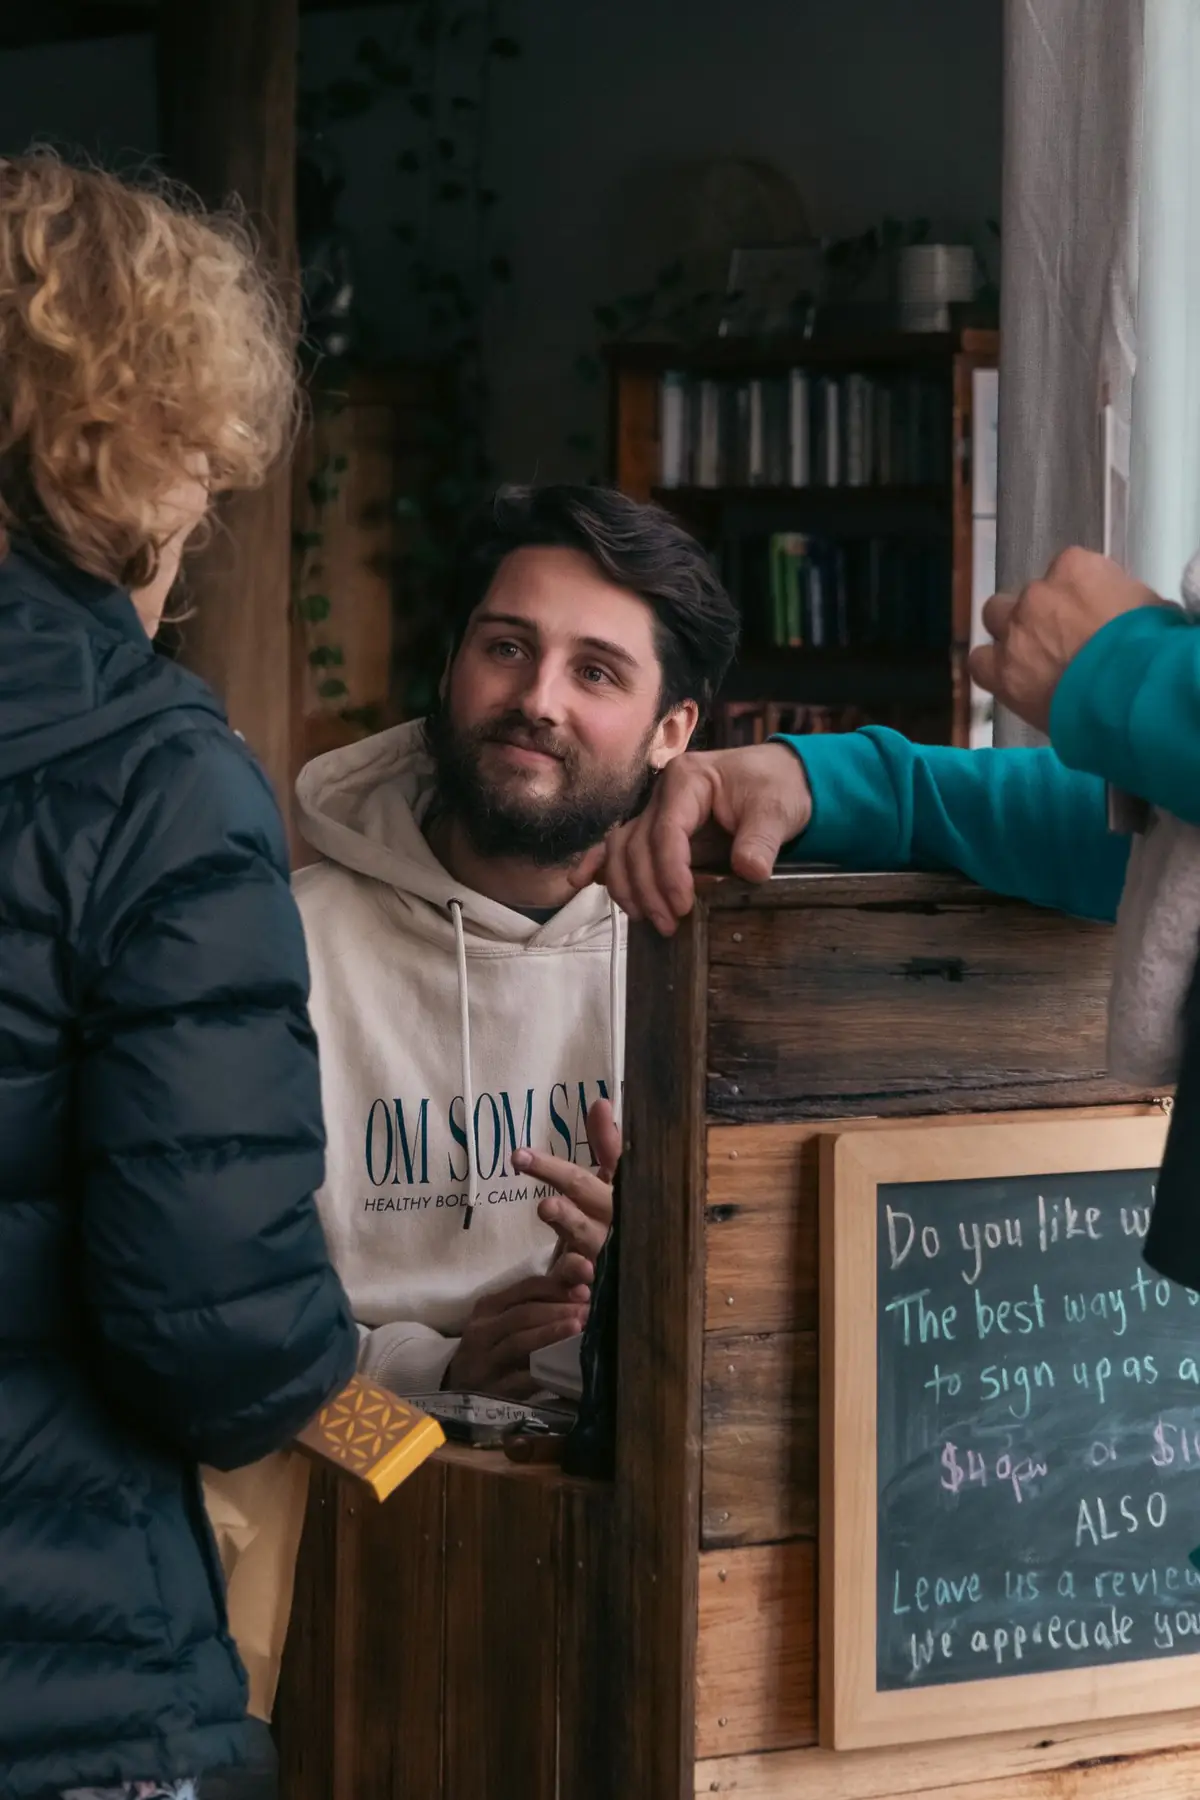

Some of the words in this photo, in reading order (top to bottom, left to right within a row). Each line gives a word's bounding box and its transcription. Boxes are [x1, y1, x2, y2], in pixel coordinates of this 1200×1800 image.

[365, 1098, 430, 1187] OM
[448, 1088, 534, 1182] SOM
[549, 1080, 624, 1167] SA
[364, 1196, 432, 1212] HEALTHY
[487, 1187, 528, 1205] CALM
[533, 1183, 562, 1199] MIN
[886, 1203, 941, 1270] Do
[959, 1218, 1023, 1286] you
[1037, 1195, 1103, 1253] like
[884, 1288, 957, 1346] The
[974, 1283, 1045, 1340] best
[1063, 1289, 1127, 1336] way
[1130, 1266, 1171, 1312] to
[924, 1364, 963, 1405] to
[980, 1354, 1055, 1420] sign
[1072, 1356, 1112, 1404] up
[1122, 1353, 1159, 1385] as
[1178, 1357, 1200, 1386] a
[1075, 1491, 1169, 1548] ALSO
[893, 1568, 983, 1615] Leave
[1005, 1570, 1041, 1602] us
[1057, 1569, 1077, 1600] a
[910, 1628, 953, 1674] We
